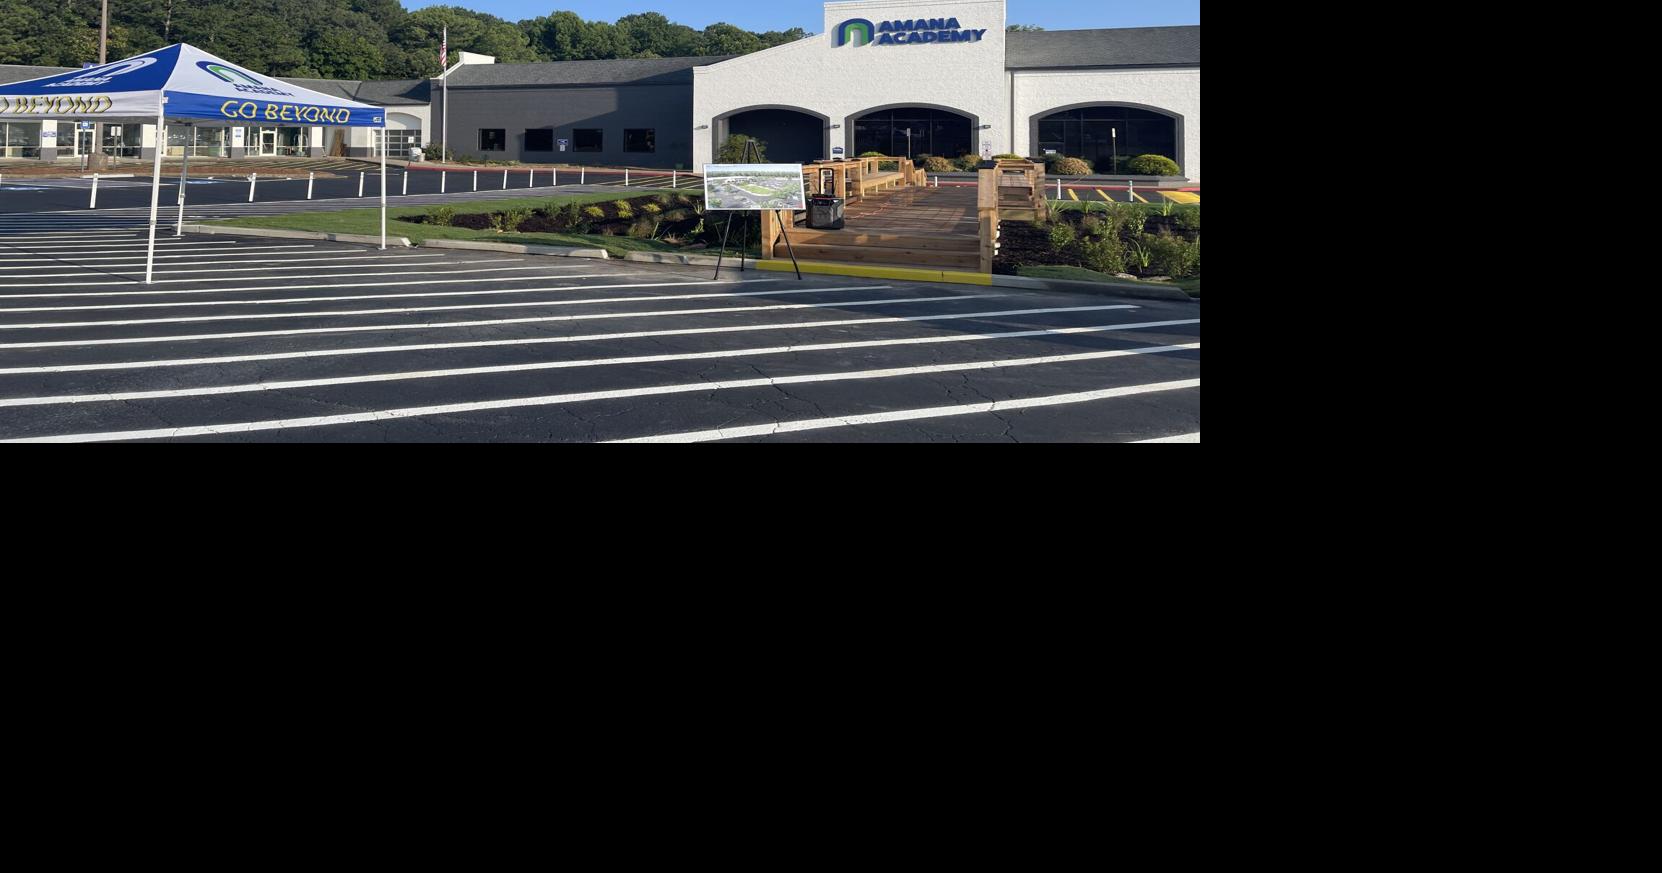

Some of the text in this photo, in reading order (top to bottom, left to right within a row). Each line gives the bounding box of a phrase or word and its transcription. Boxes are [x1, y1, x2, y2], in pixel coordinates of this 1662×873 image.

[878, 17, 961, 32] AMANA
[878, 29, 987, 45] ACADEMY
[14, 95, 113, 114] BEYOND
[220, 101, 350, 123] GO BEYOND
